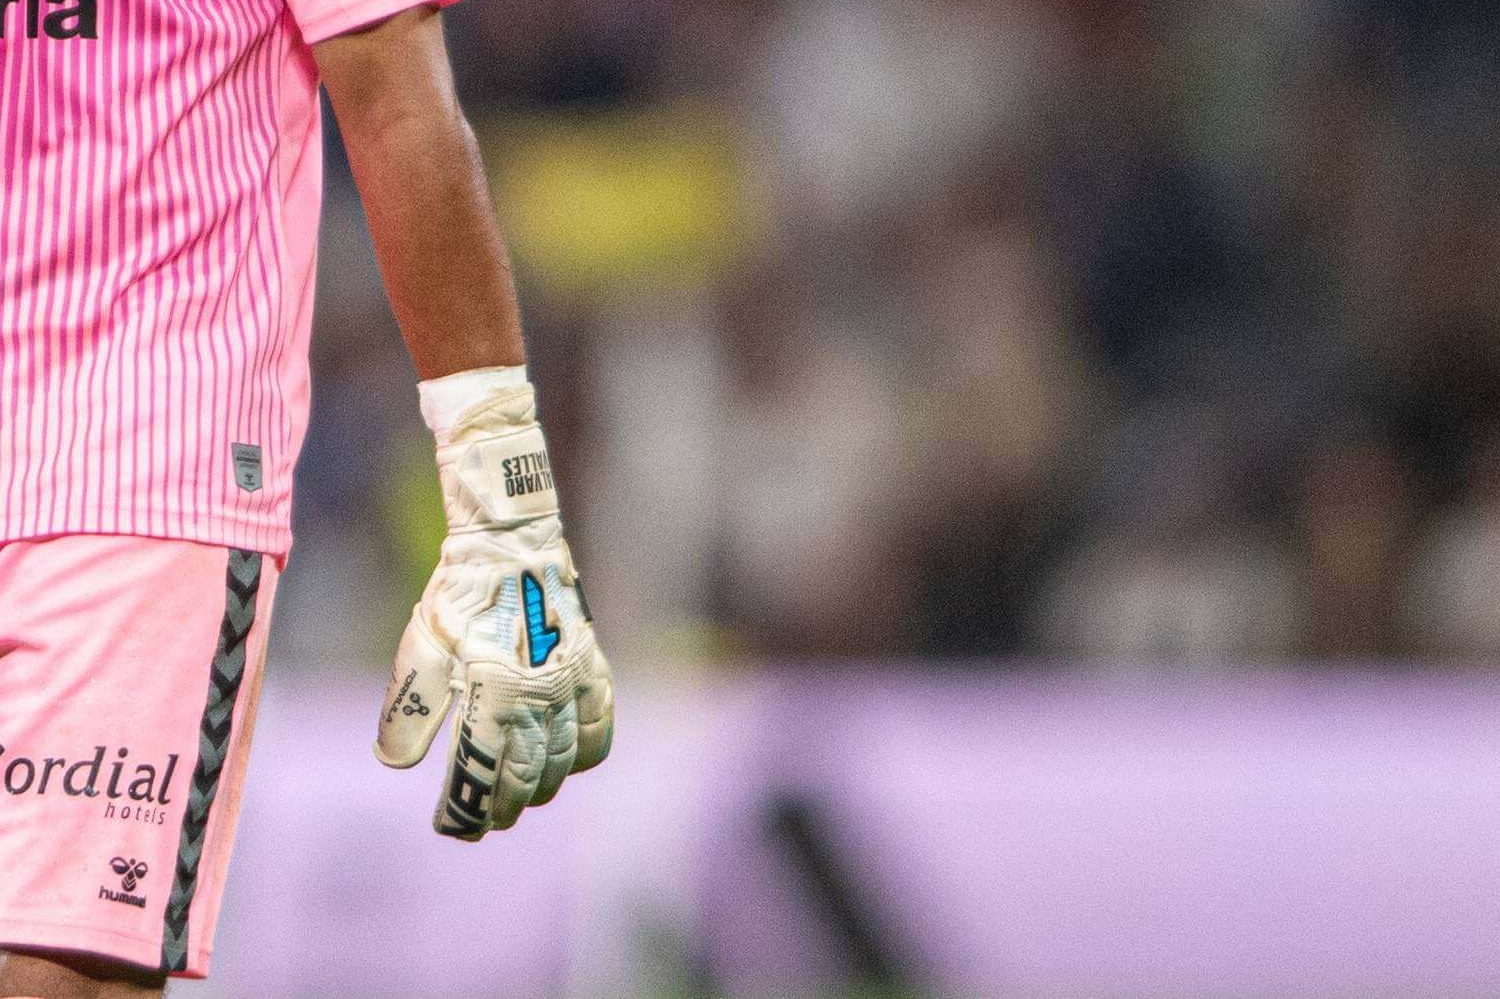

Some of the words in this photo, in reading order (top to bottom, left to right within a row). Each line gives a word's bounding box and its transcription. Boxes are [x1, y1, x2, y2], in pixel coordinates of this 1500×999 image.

[501, 449, 550, 478] VALLES
[505, 470, 553, 498] ALVARO
[104, 801, 166, 825] hotels
